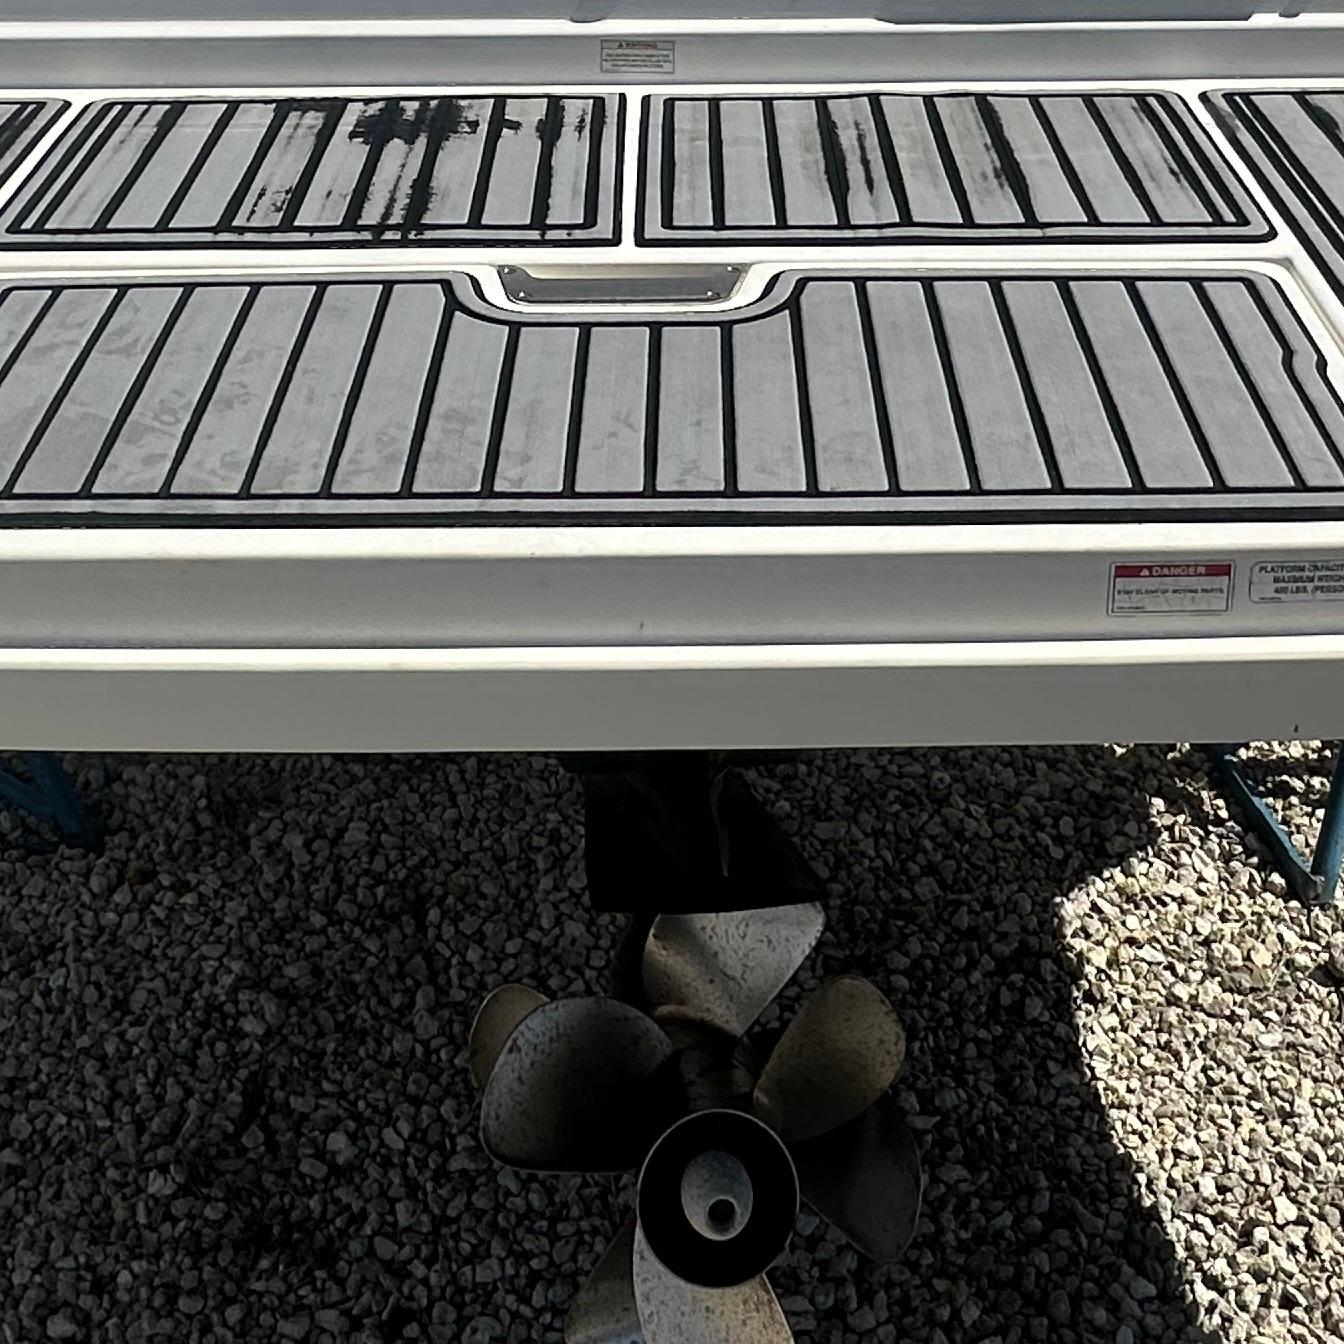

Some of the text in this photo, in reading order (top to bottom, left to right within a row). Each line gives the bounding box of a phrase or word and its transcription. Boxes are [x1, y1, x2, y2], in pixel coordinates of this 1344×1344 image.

[1152, 566, 1206, 576] DANGER
[1259, 565, 1306, 574] PLATFORM
[1273, 574, 1315, 584] MAXIMUM
